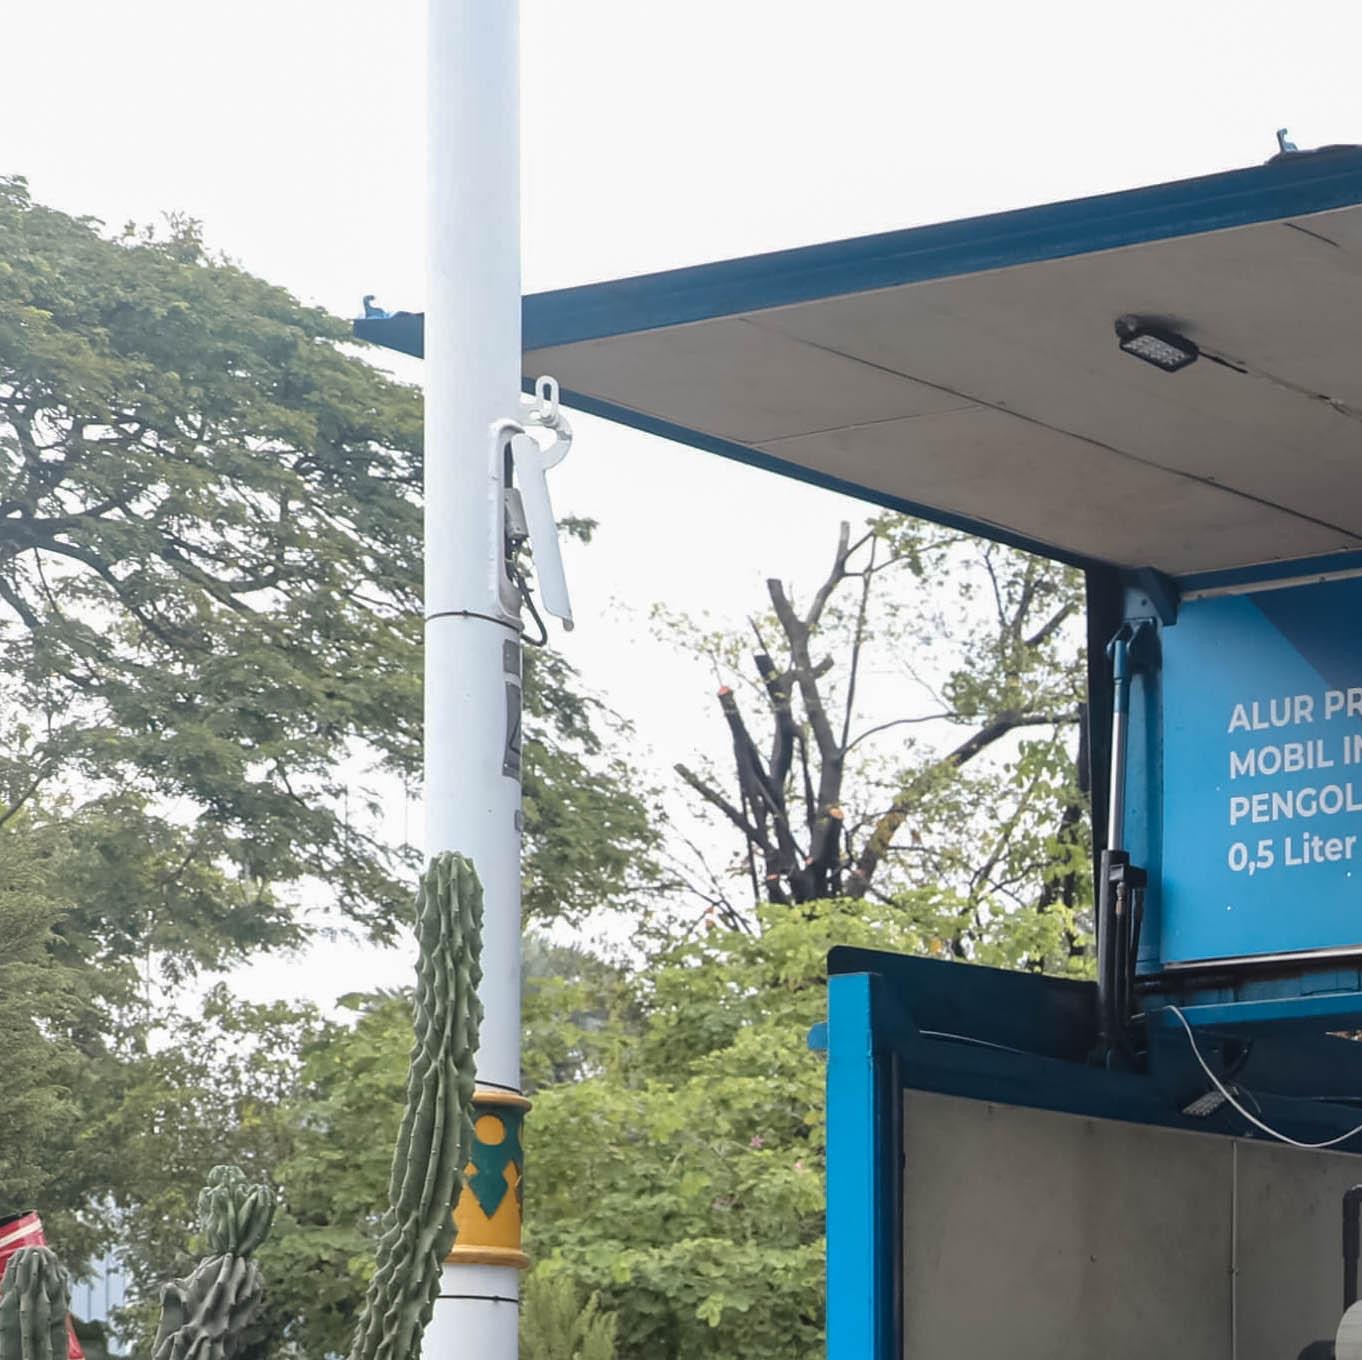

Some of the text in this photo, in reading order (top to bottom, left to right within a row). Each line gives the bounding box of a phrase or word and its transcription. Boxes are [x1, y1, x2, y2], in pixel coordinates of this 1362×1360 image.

[1227, 695, 1314, 733] ALUR
[1229, 739, 1334, 779] MOBIL
[1227, 840, 1274, 875] 0,5
[1285, 832, 1356, 866] Liter
